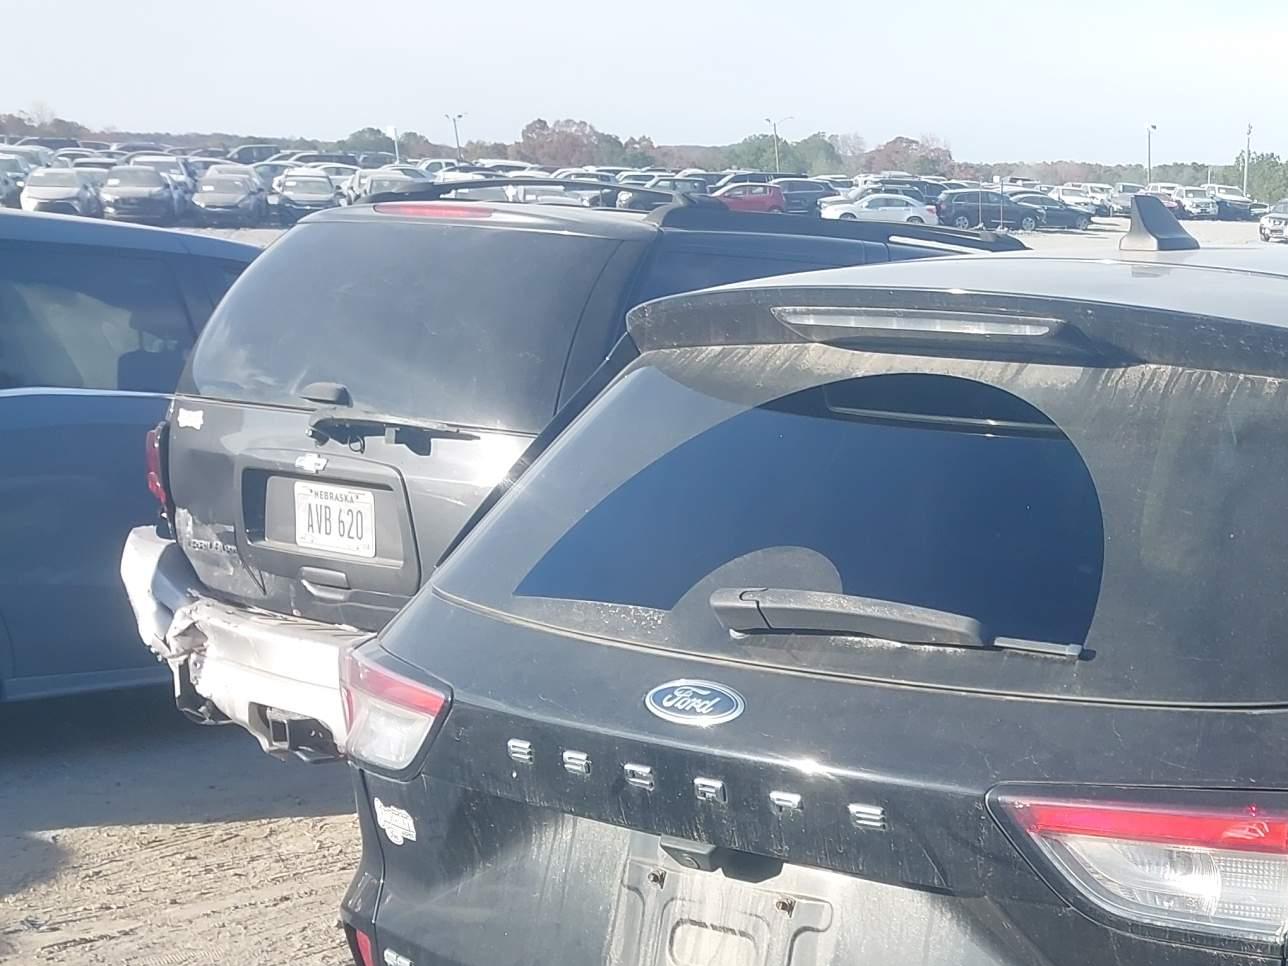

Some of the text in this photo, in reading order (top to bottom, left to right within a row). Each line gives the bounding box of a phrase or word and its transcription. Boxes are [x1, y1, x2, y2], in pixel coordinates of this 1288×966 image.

[314, 490, 355, 504] NEBRASKA
[307, 503, 364, 541] AVB 620
[662, 686, 721, 714] Ford
[507, 738, 888, 831] ESCAPE
